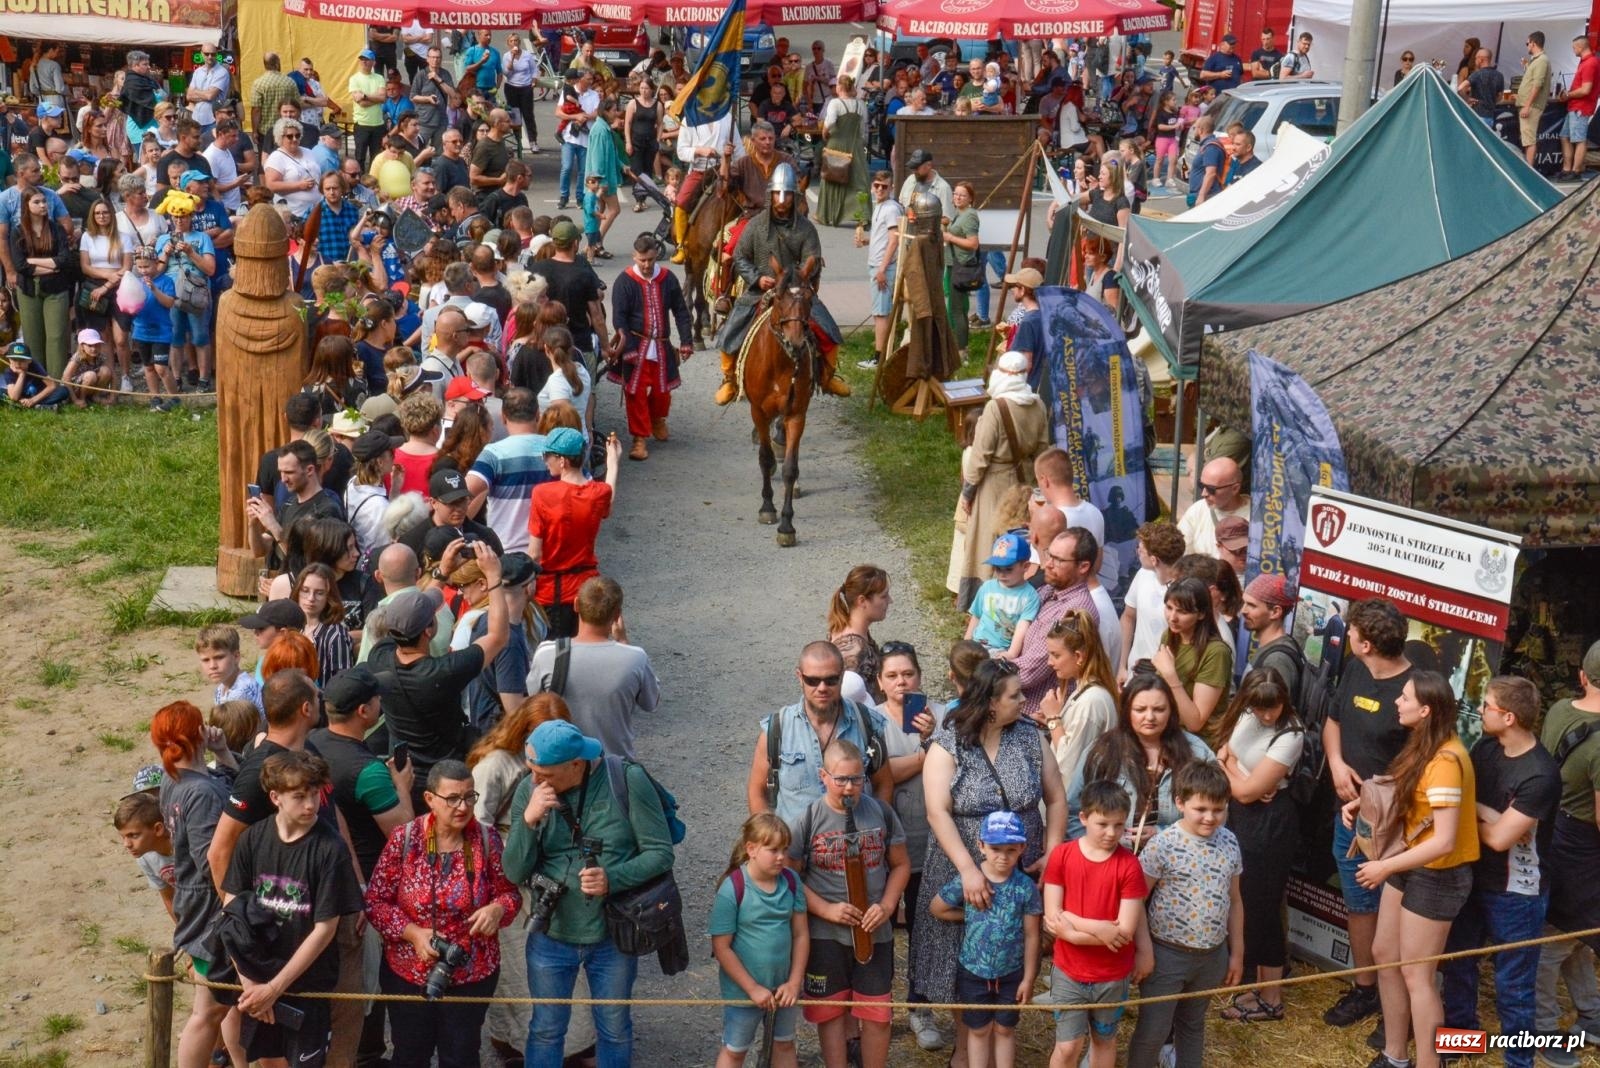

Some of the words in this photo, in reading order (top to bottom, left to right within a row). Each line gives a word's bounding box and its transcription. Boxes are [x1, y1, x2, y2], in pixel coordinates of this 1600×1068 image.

[0, 0, 170, 23] WIARENKA
[319, 4, 403, 22] RACIBORSKIE
[429, 11, 522, 26] RACIBORSKIE
[542, 8, 586, 25] RACIBORSKIE
[782, 5, 842, 21] RACIBORSKIE
[909, 20, 989, 36] RACIBORSKIE
[1013, 20, 1104, 36] RACIBORSKIE
[1122, 15, 1168, 31] RACIBORSKIE
[1346, 521, 1404, 545] JEDNOSTKA
[1407, 537, 1472, 563] STRZELECKA
[1367, 542, 1391, 556] 3054
[1394, 547, 1445, 571] RACIBÓRZ
[1309, 563, 1341, 583] WYJDŹ
[1342, 573, 1350, 585] Z
[1351, 576, 1386, 595] DOMU!
[1387, 584, 1427, 606] ZOSTAŃ
[1428, 599, 1498, 626] STRZELCEM!
